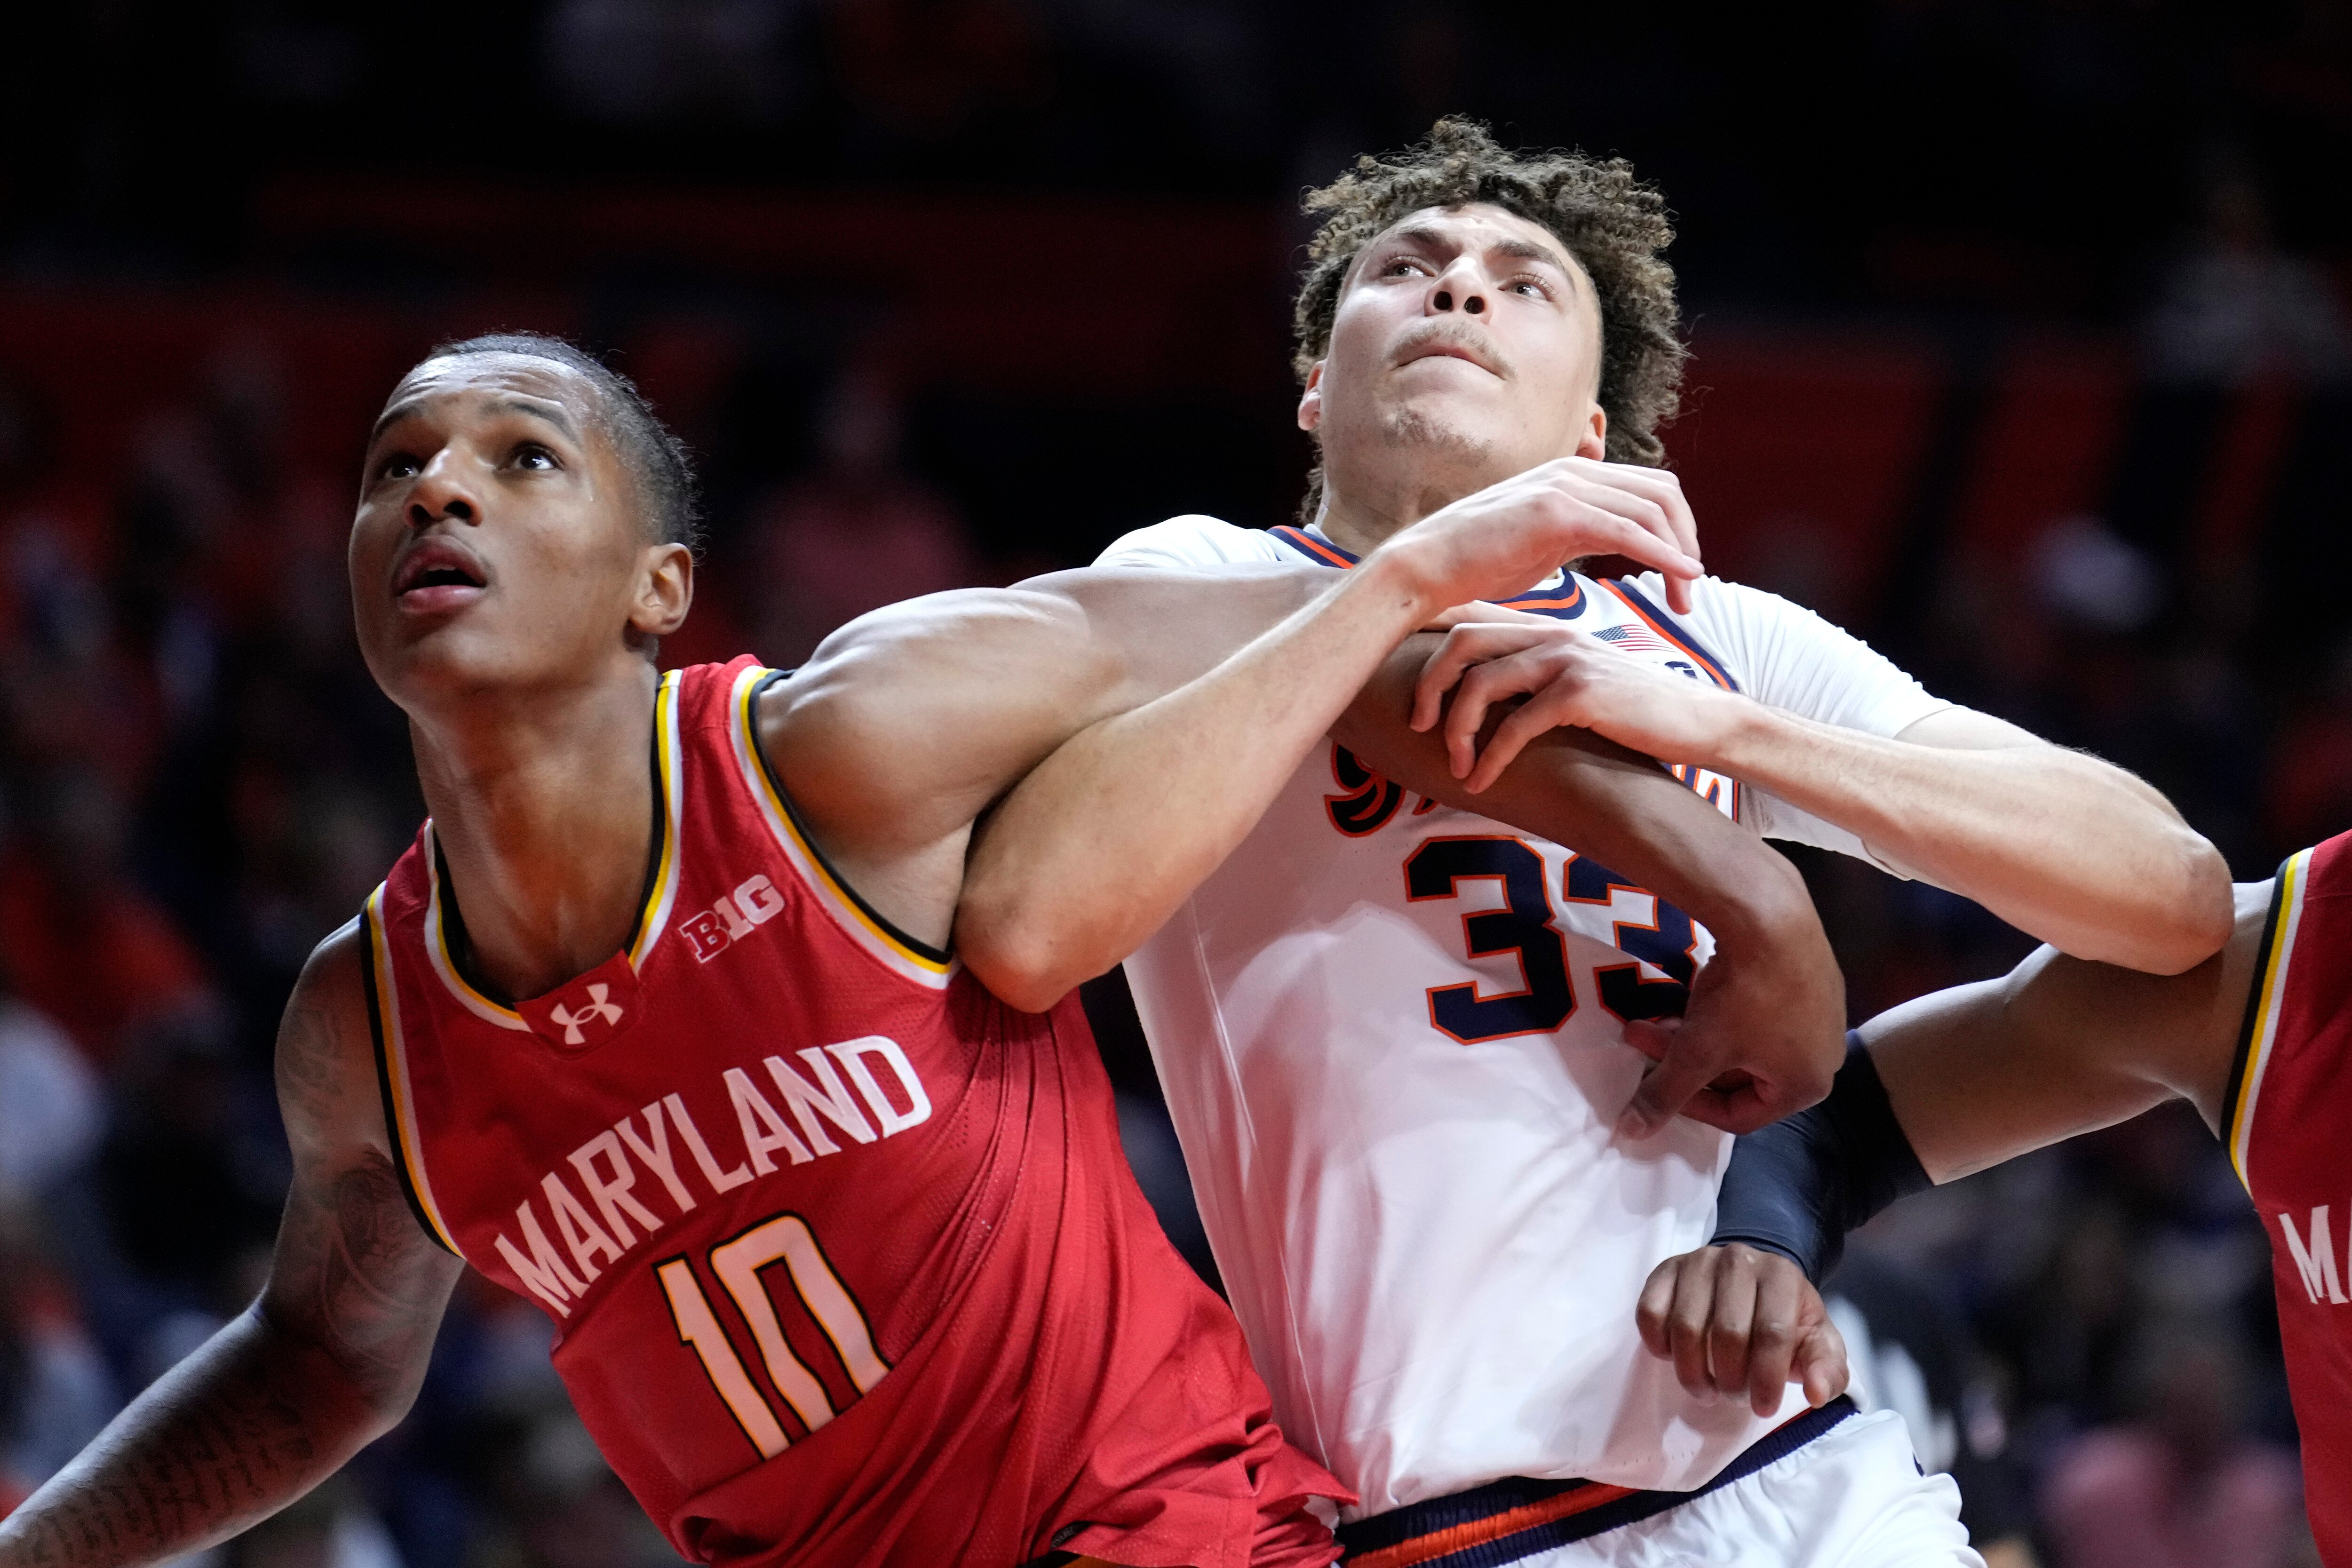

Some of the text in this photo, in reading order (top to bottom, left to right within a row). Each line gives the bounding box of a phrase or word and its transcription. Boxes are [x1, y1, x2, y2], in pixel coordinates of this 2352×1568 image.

[1402, 833, 1698, 1046] 33
[494, 1035, 932, 1318] MARYLAND
[2278, 1198, 2352, 1305] M
[652, 1210, 894, 1461] 10
